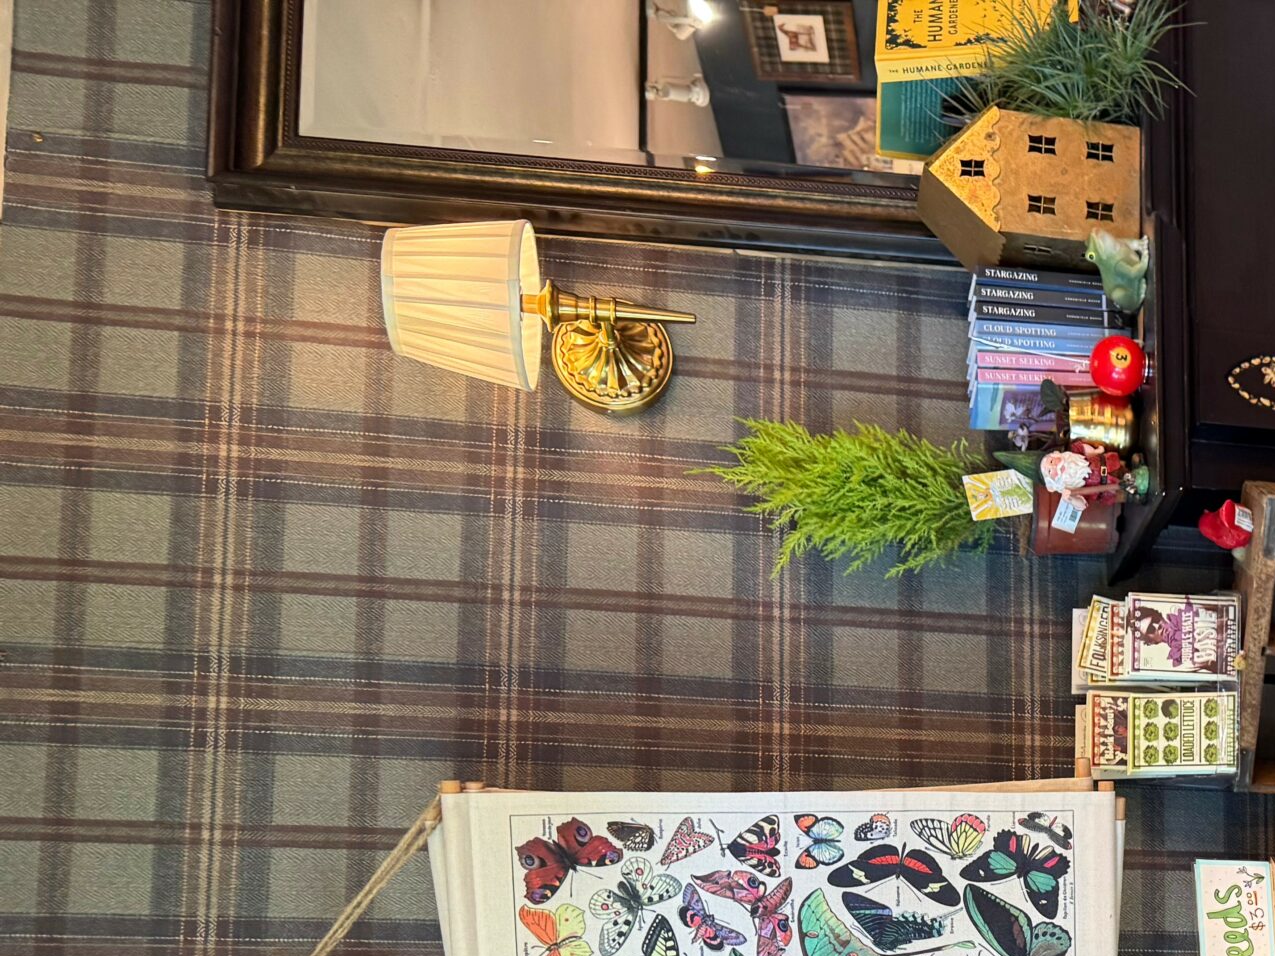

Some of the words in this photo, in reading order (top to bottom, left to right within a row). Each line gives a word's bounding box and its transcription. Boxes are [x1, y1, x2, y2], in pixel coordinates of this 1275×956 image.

[914, 10, 923, 24] THE
[928, 0, 942, 42] HUMAN
[948, 0, 958, 35] GARDENE
[902, 64, 942, 74] HUMANE
[984, 268, 1038, 281] STARGAZING
[980, 288, 1034, 299] STARGAZING
[982, 305, 1036, 317] STARGAZING
[984, 324, 1011, 333] CLOUD
[1014, 326, 1057, 336] SPOTTING
[1014, 338, 1056, 348] SPOTTING
[1020, 357, 1055, 365] SEEKING
[984, 372, 1018, 380] SUNSET
[1180, 610, 1194, 633] HAZE
[1194, 610, 1218, 662] BASIL
[1181, 635, 1194, 663] PURPLE
[1180, 700, 1195, 731] LETTUCE
[1103, 737, 1114, 760] Black
[1181, 732, 1195, 762] LOADED
